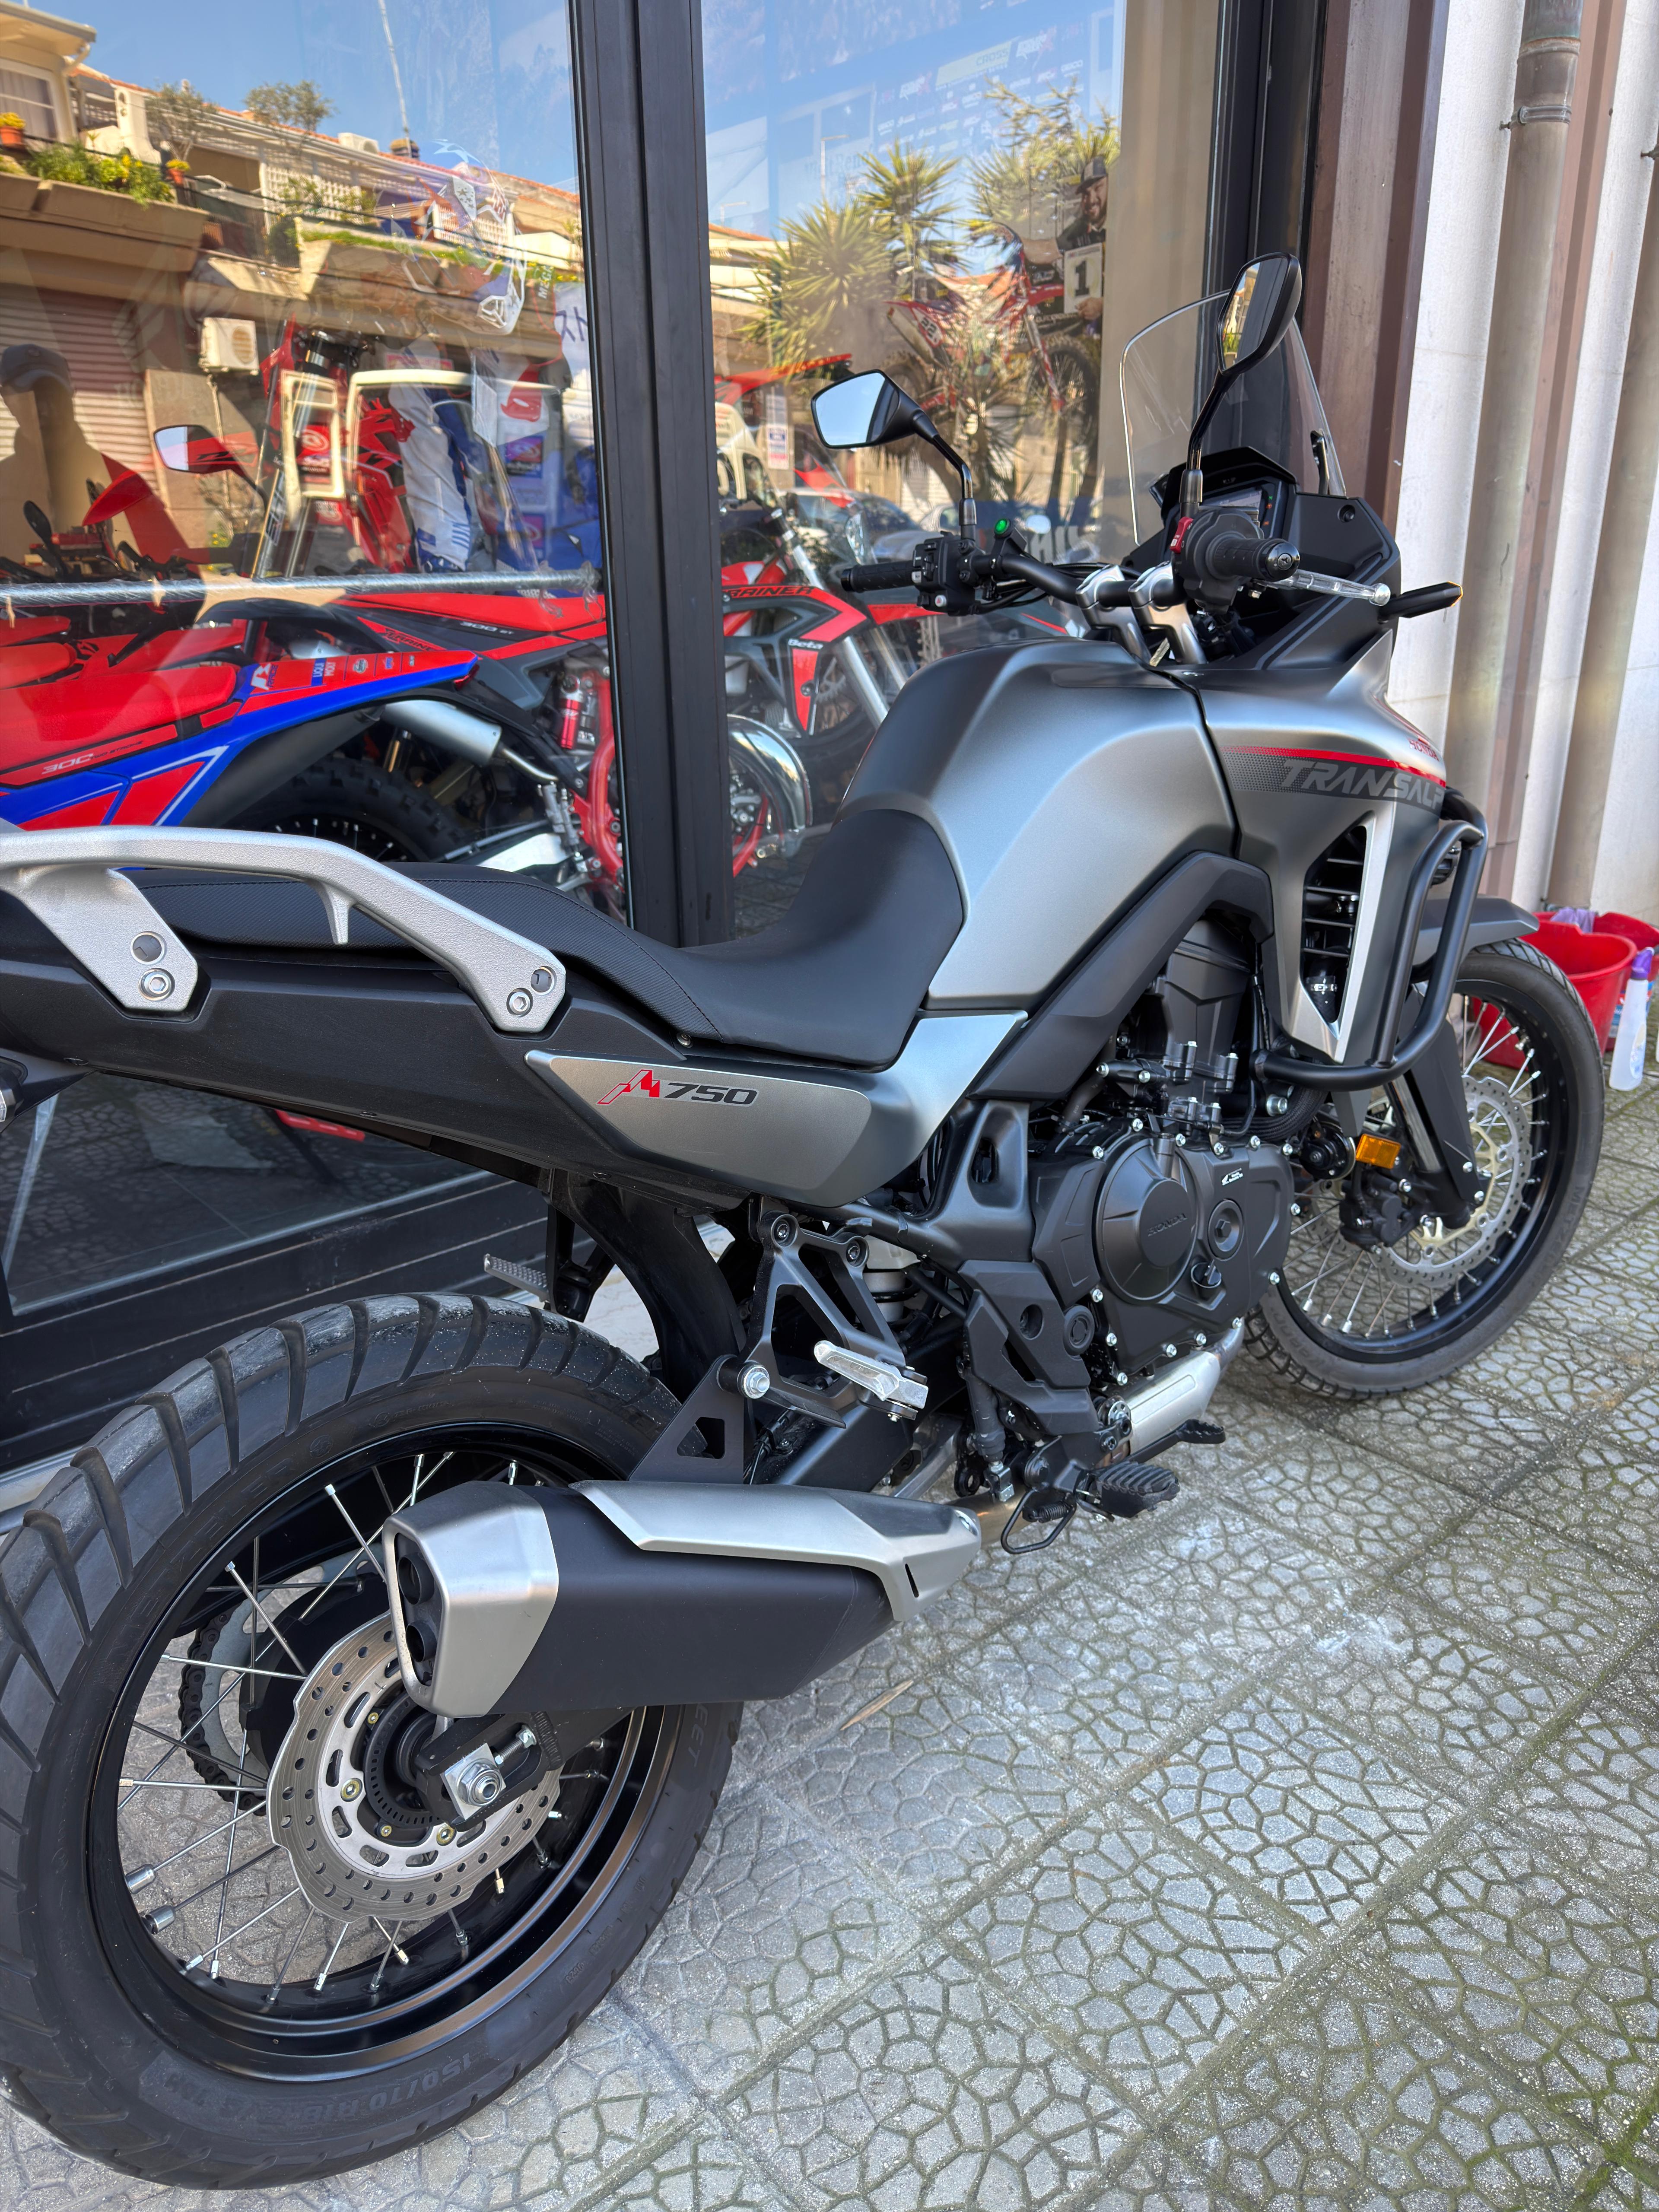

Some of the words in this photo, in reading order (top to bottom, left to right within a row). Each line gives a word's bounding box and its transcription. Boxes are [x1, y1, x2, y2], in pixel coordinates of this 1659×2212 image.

[1075, 260, 1089, 296] 1
[788, 639, 824, 650] Beta
[1407, 738, 1440, 762] HONDA
[1282, 759, 1444, 809] TRANSALP
[664, 1082, 758, 1106] 750
[1147, 1213, 1188, 1237] HONDA
[369, 2052, 472, 2111] 150/70
